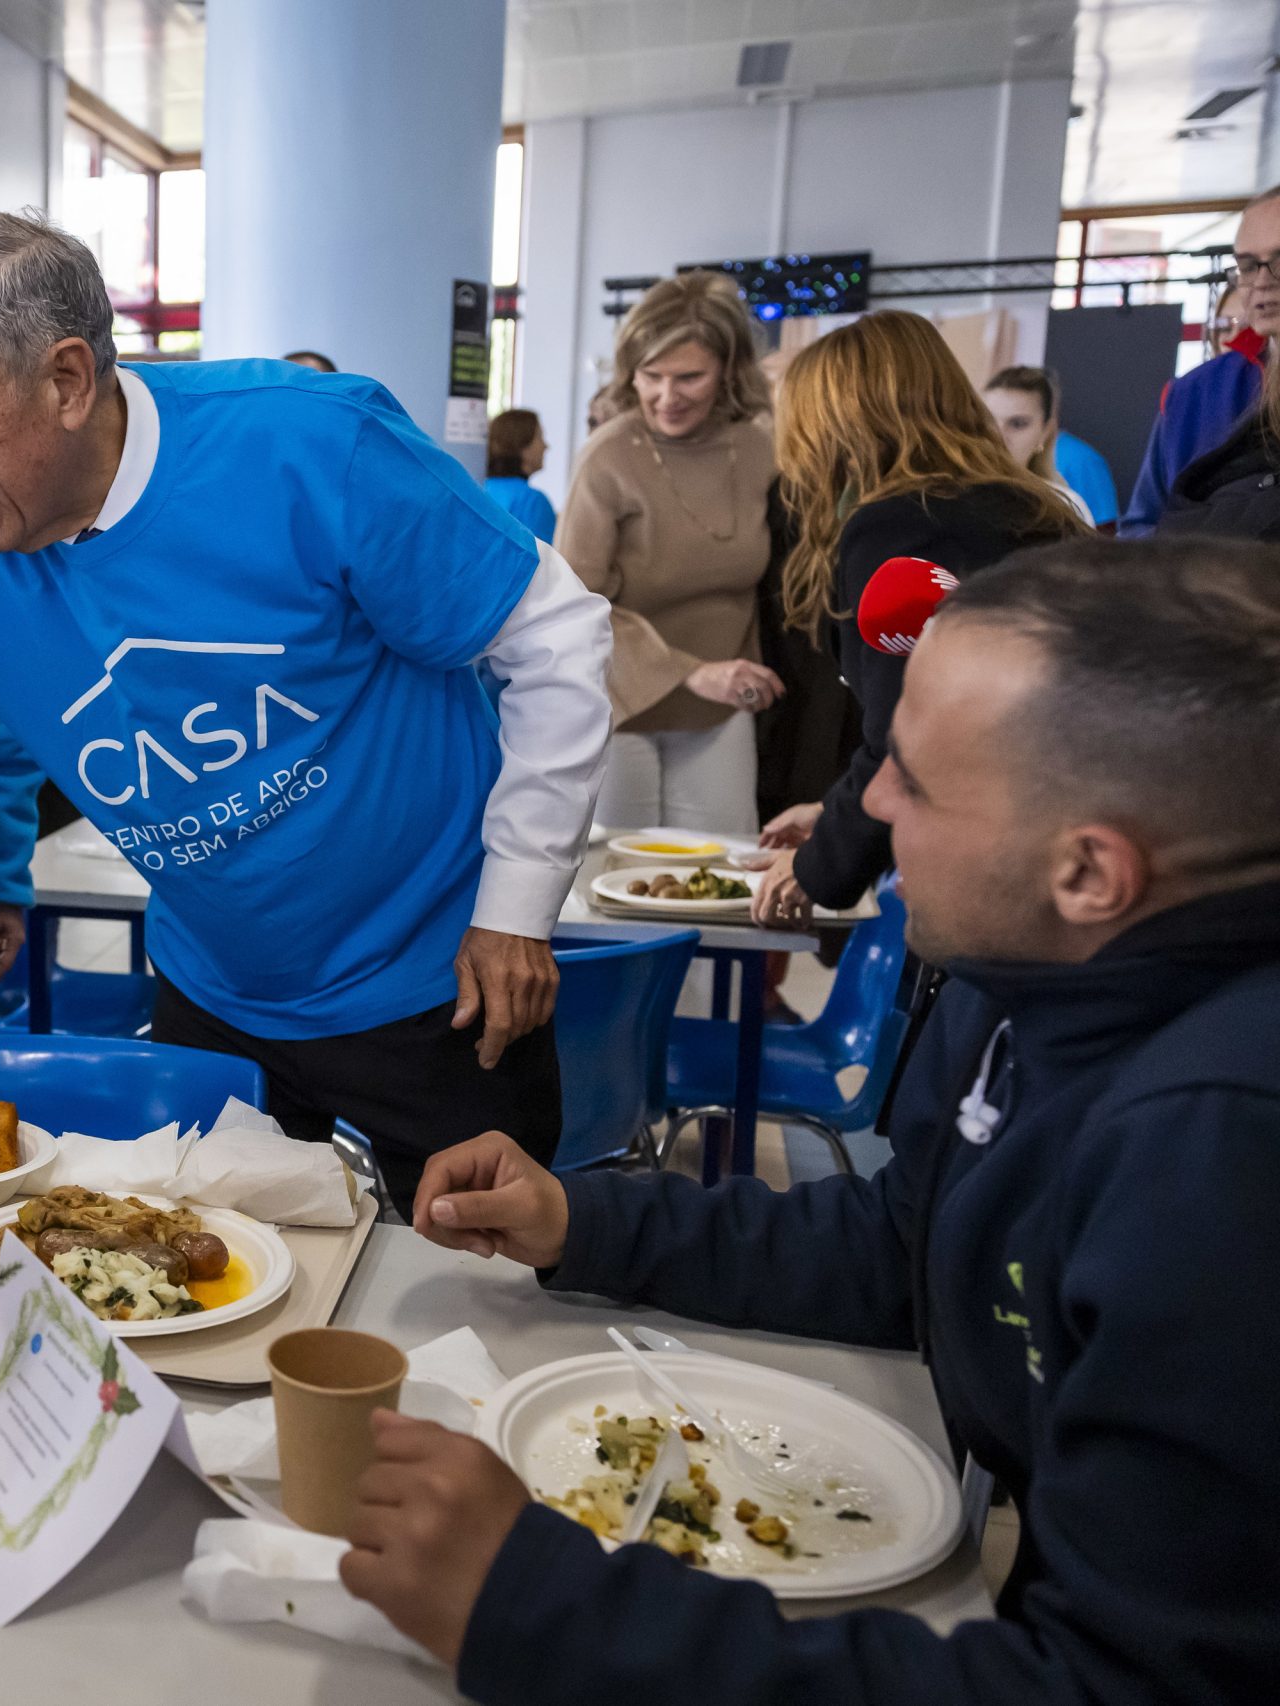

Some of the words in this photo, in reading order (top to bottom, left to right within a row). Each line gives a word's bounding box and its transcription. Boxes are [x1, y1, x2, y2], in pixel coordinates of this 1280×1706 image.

[77, 683, 320, 806] CASA
[171, 834, 227, 867] SEM
[237, 766, 328, 841] ABRIGO
[207, 792, 250, 827] DE
